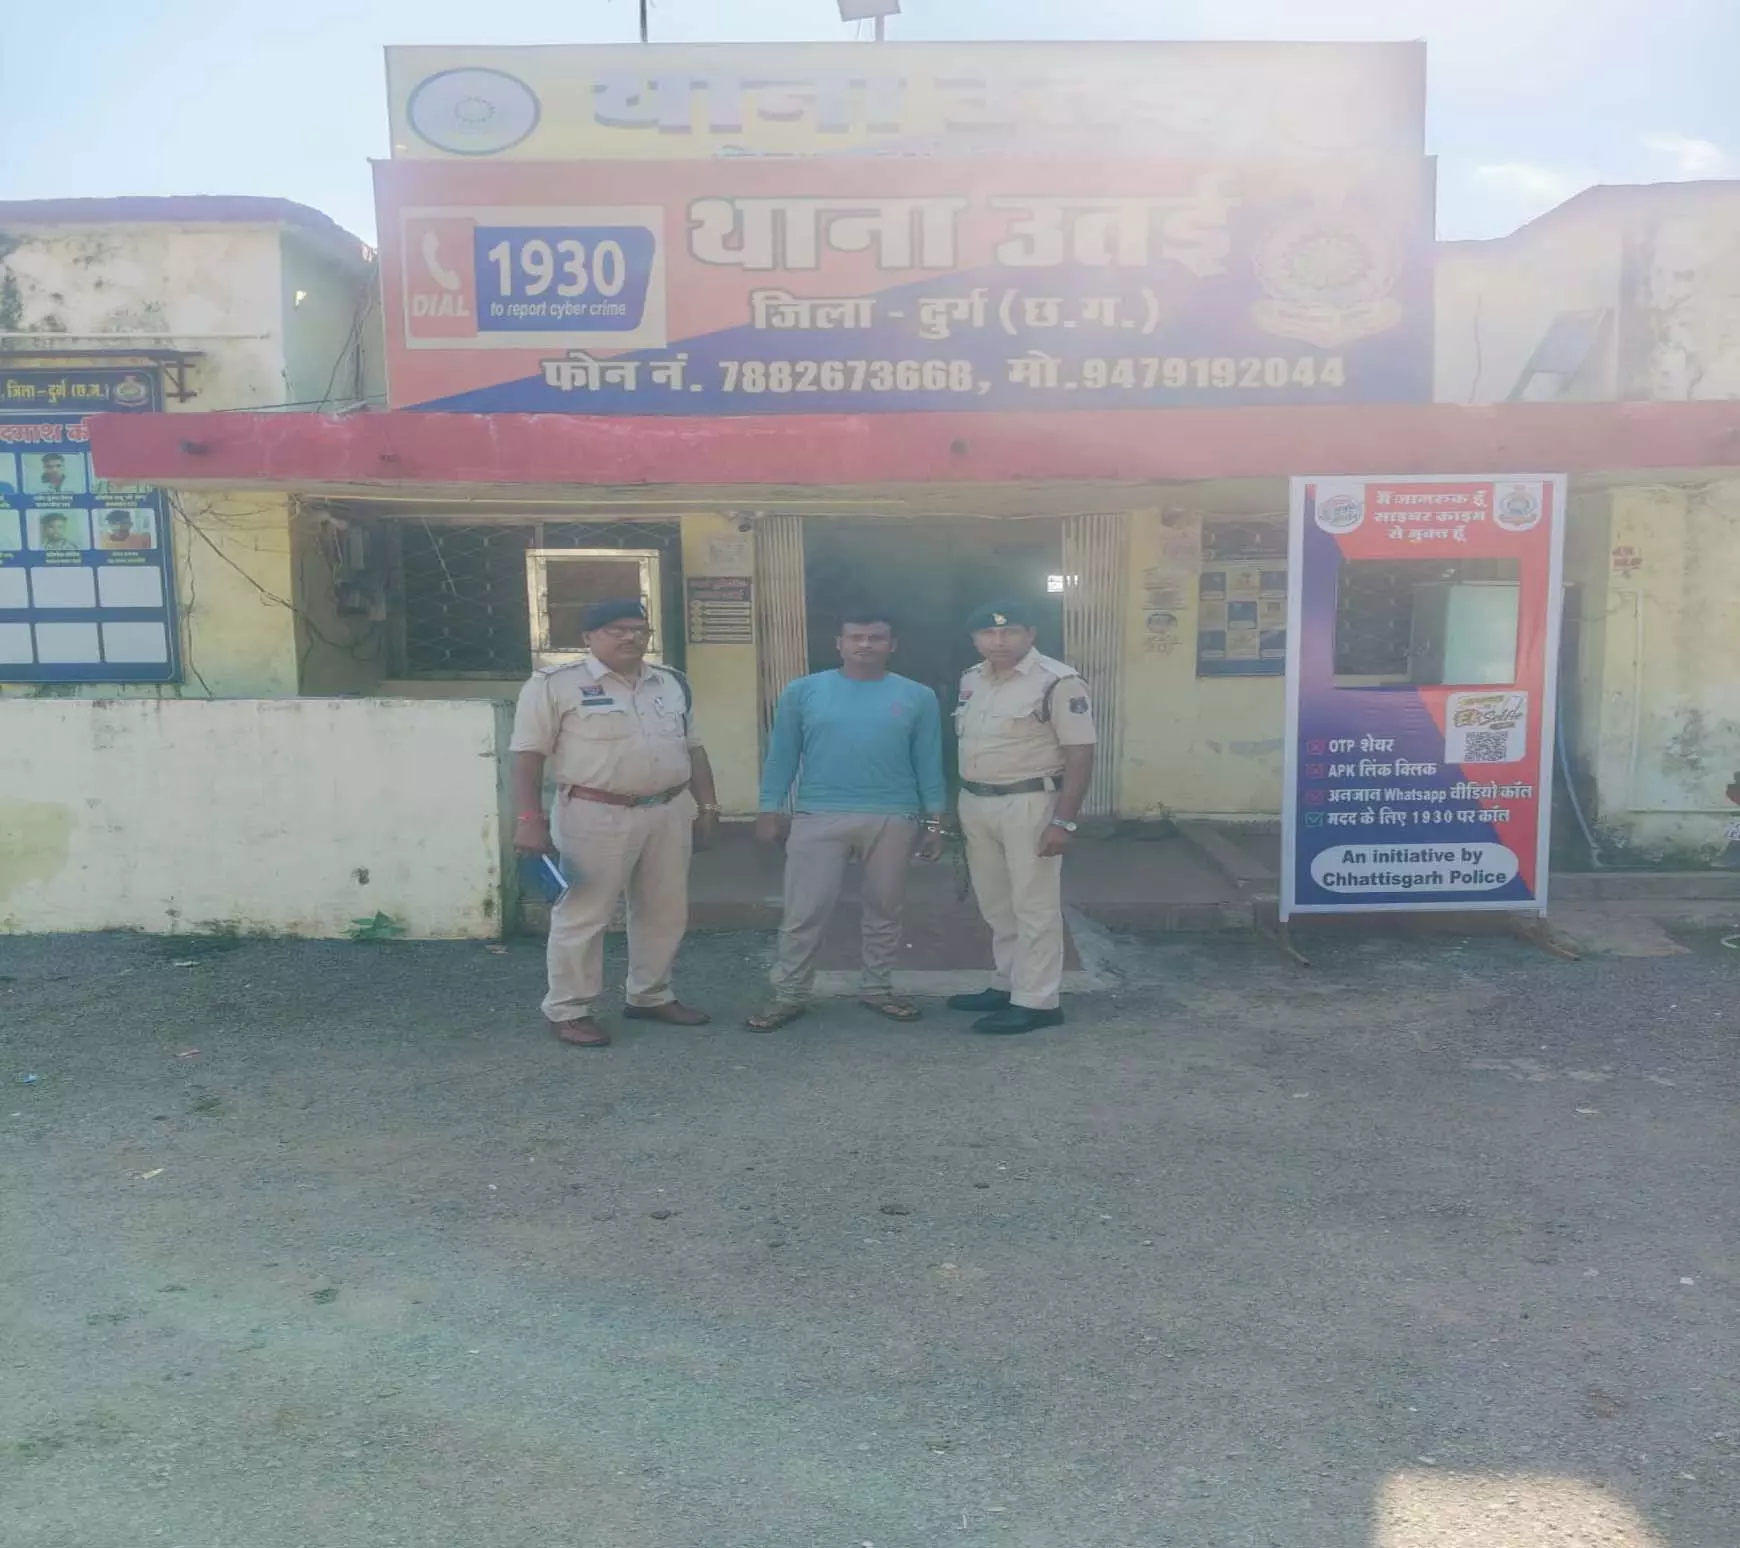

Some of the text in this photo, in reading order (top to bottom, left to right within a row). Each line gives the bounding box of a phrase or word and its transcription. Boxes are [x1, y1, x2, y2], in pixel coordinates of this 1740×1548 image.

[687, 167, 1242, 279] थाना उतई
[488, 239, 626, 298] 1930
[411, 293, 471, 318] DIAL
[490, 301, 626, 320] to report cyber crime
[752, 287, 877, 330] जिला
[919, 286, 989, 339] दुर्ग
[541, 349, 642, 392] फोन
[649, 350, 704, 392] नं.
[719, 358, 991, 396] 7882673668,
[1328, 734, 1395, 753] OTP शेयर
[1328, 764, 1355, 778] APK
[1359, 758, 1391, 777] लिंक
[1328, 781, 1533, 804] अनजान Whatsapp वीडियो कॉल
[1327, 805, 1510, 827] मदद के लिए 1930 पर कॉल
[1341, 848, 1483, 865] An initiative by
[1322, 869, 1508, 889] Chhattisgarh Police
